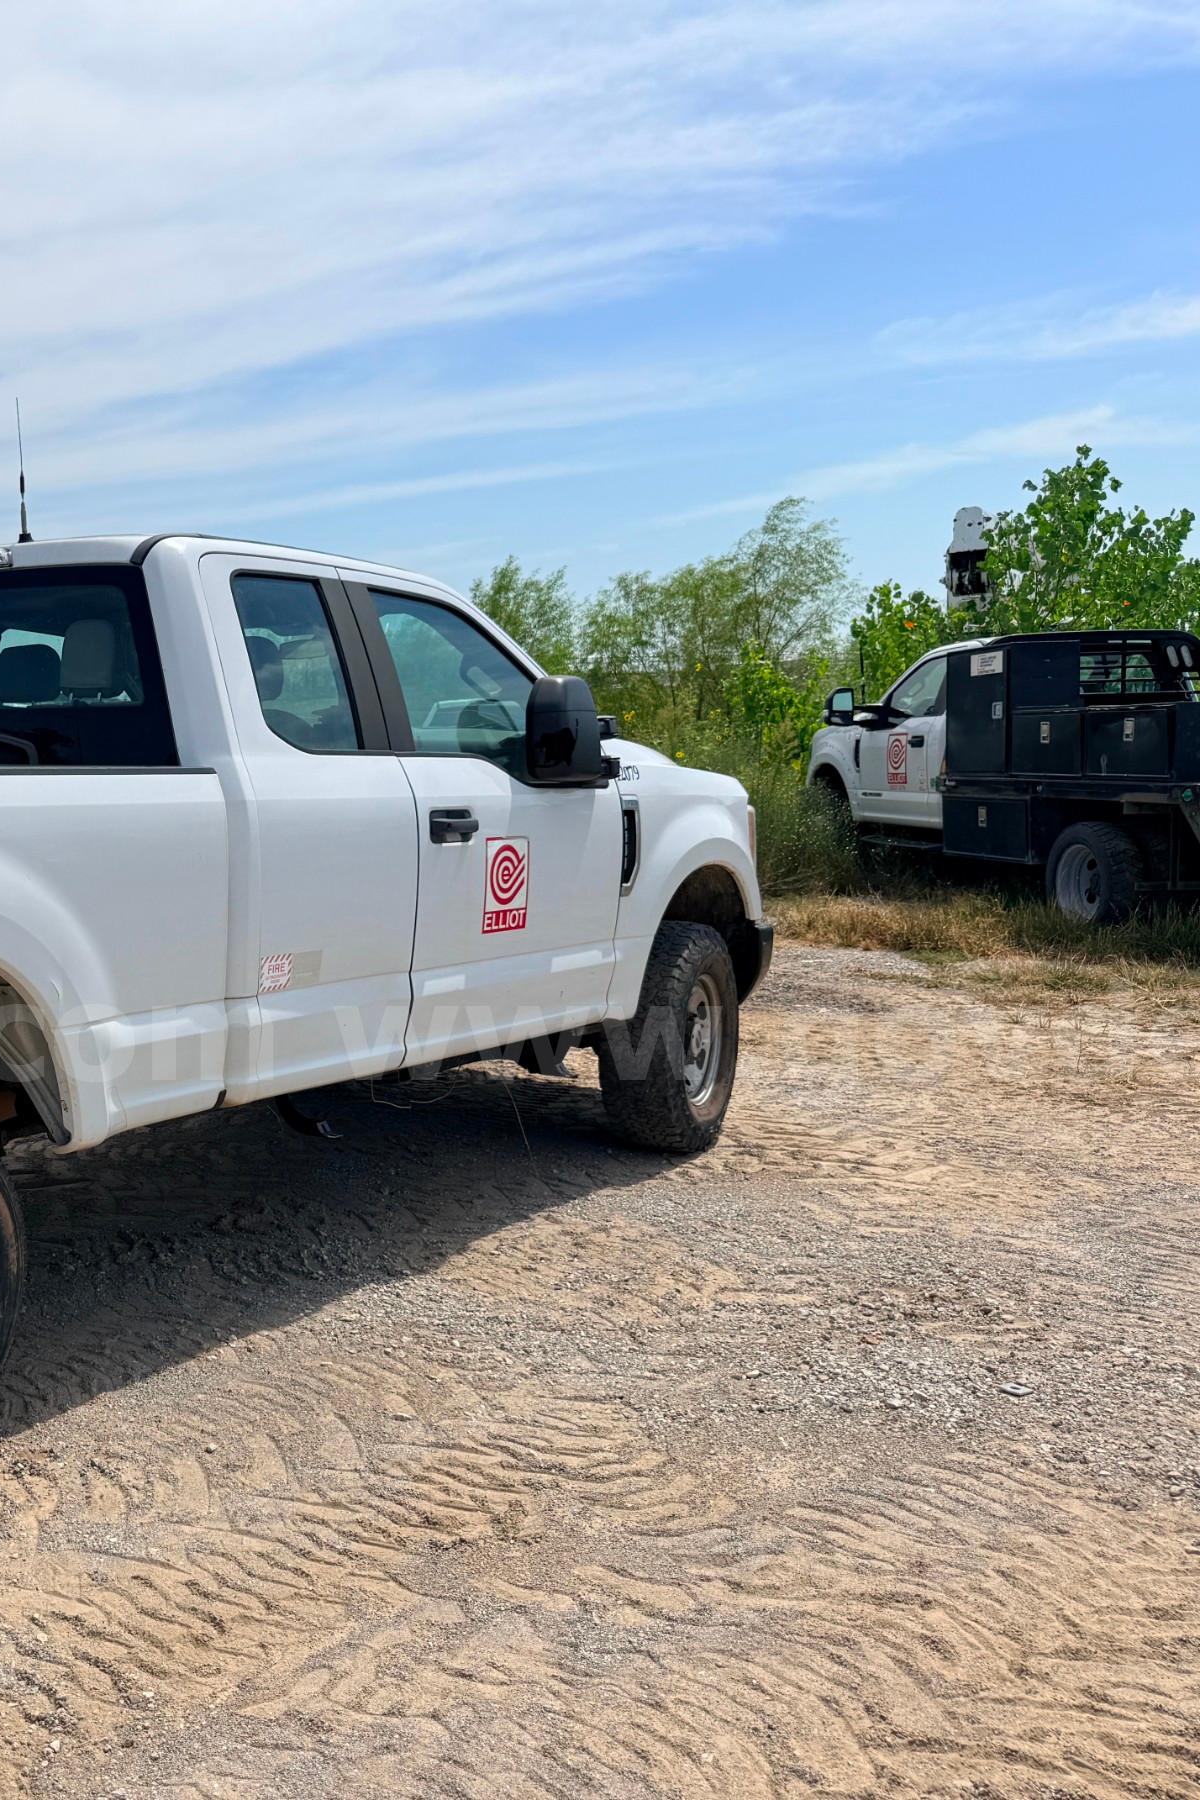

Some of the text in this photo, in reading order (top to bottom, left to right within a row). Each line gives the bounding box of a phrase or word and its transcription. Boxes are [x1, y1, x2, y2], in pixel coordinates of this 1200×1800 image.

[618, 765, 640, 781] 2079
[483, 910, 526, 931] ELLIOT
[267, 962, 286, 976] FIRE
